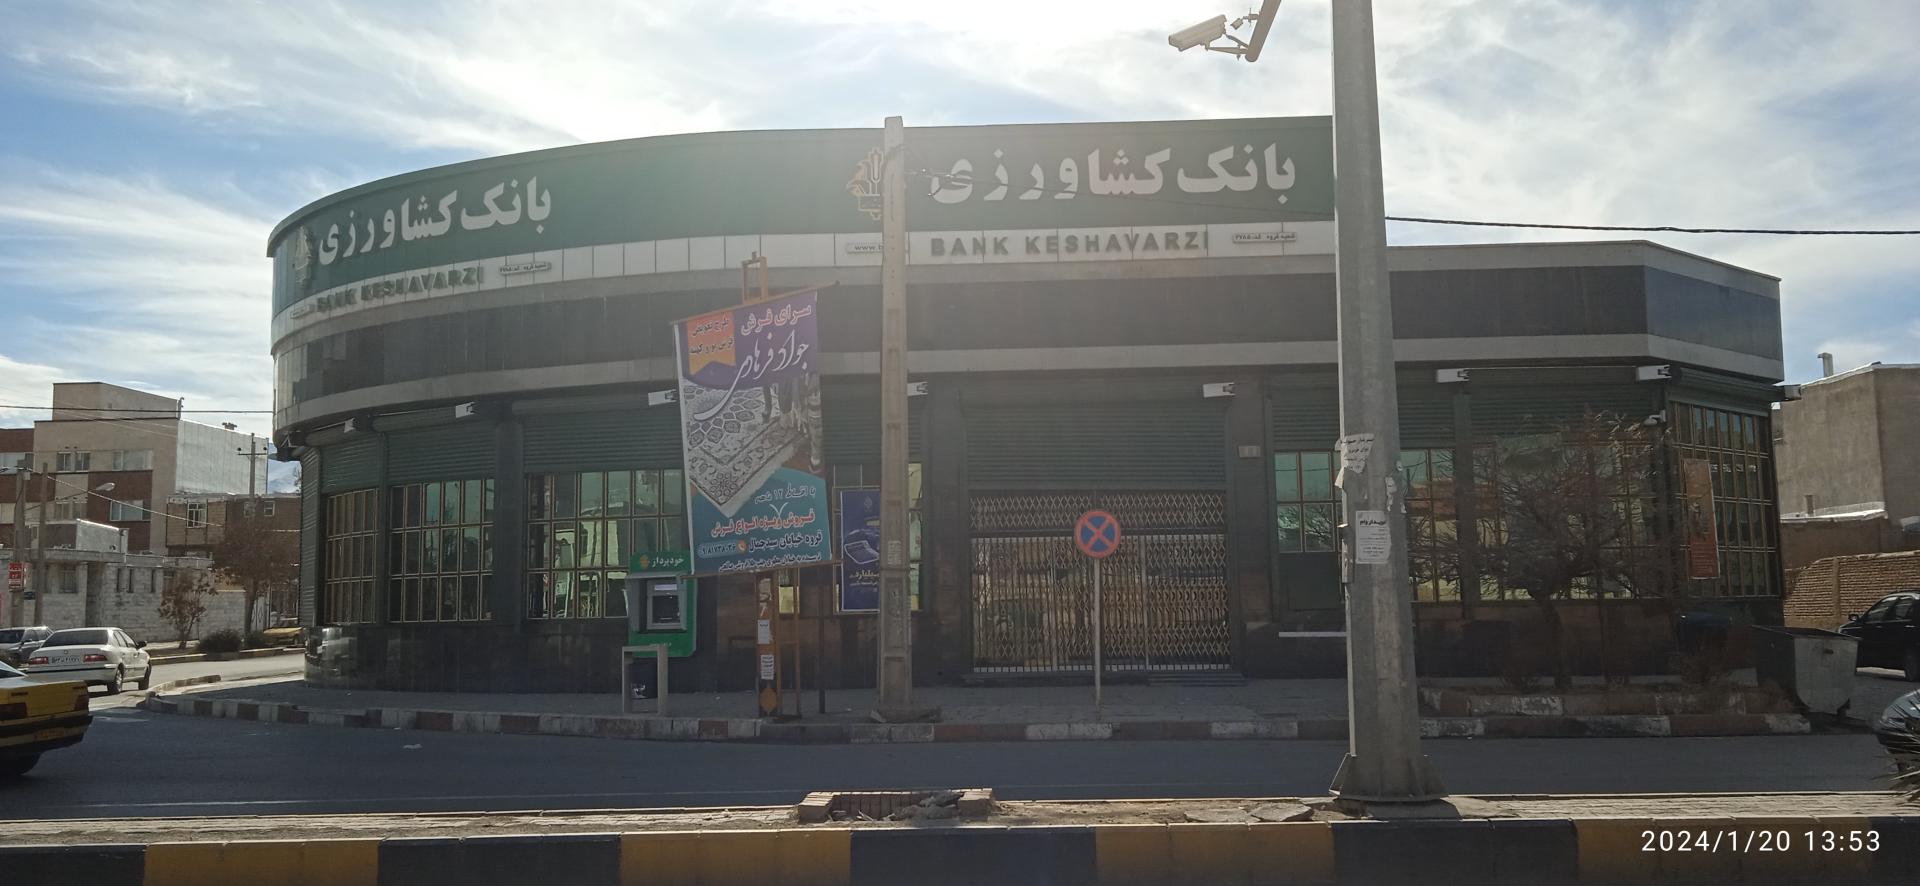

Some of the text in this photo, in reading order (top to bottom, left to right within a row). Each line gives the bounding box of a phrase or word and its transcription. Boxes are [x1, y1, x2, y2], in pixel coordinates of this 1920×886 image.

[930, 142, 1296, 205] بانک کشاورزی
[318, 176, 552, 266] بانک کشاورزی
[931, 230, 1208, 257] BANK KESHAVARZI
[316, 267, 485, 313] BANK KESHAVARZI
[741, 304, 812, 336] سرای فرش
[694, 329, 809, 421] جواد فرهادی
[711, 507, 816, 538] فروش ویژه انواع فرش
[804, 529, 824, 547] قروه
[778, 531, 804, 549] خیابان
[651, 555, 685, 568] خودپرداز
